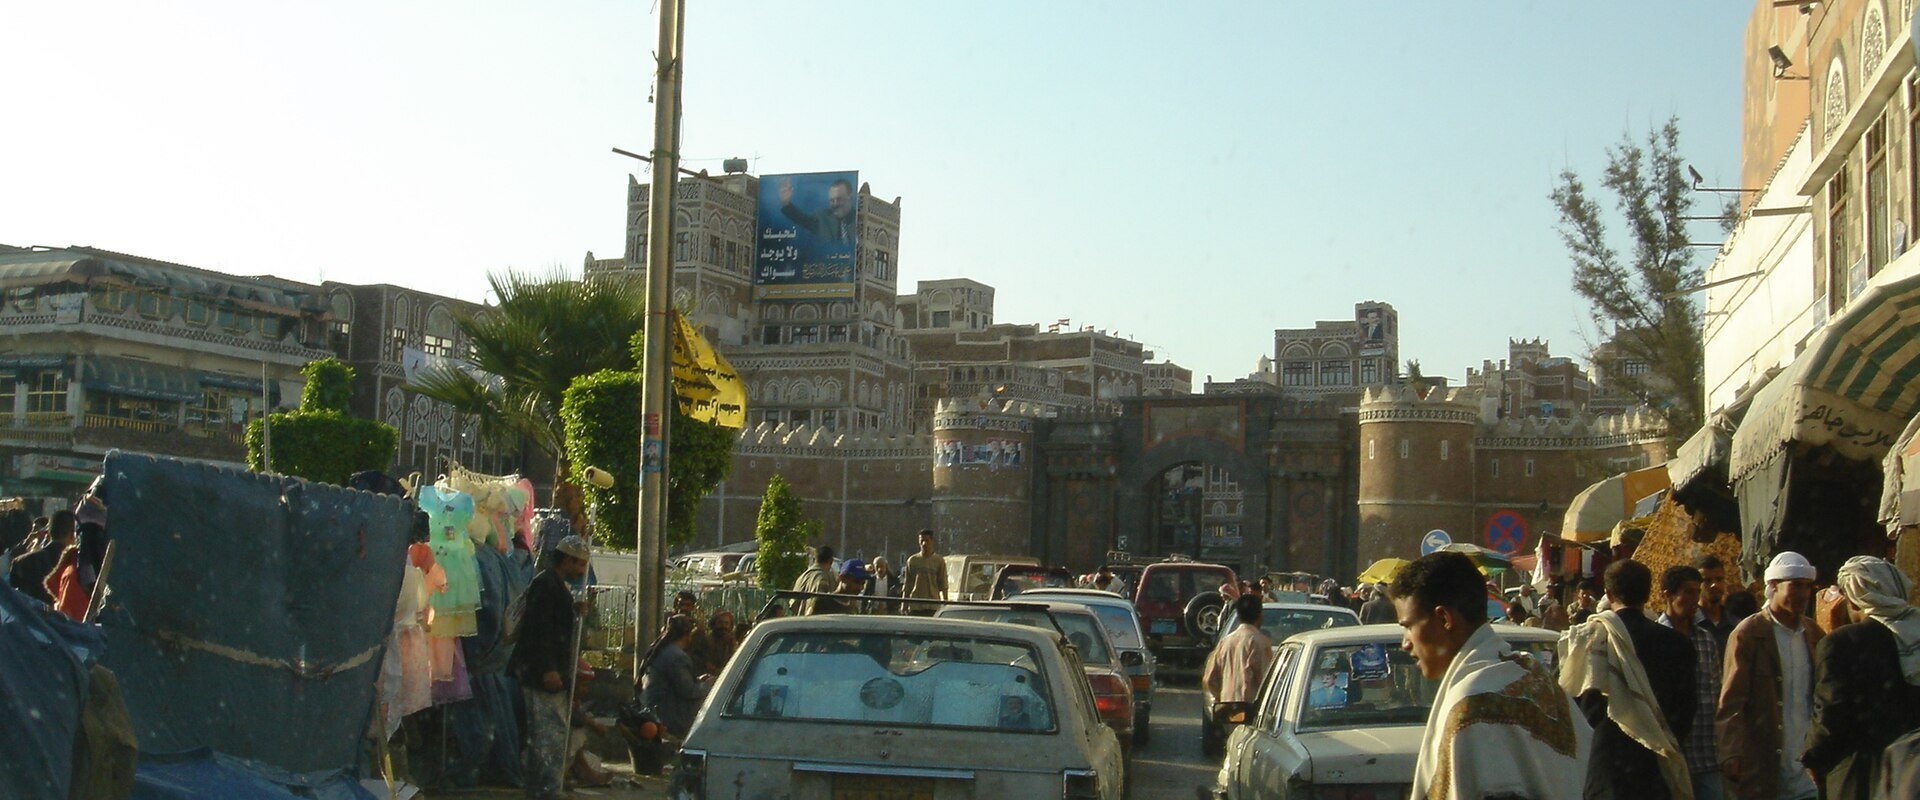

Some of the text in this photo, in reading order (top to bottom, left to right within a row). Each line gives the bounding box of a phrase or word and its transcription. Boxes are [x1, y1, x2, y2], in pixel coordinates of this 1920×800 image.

[763, 226, 797, 241] نحبك
[761, 245, 798, 261] ولا يوجد
